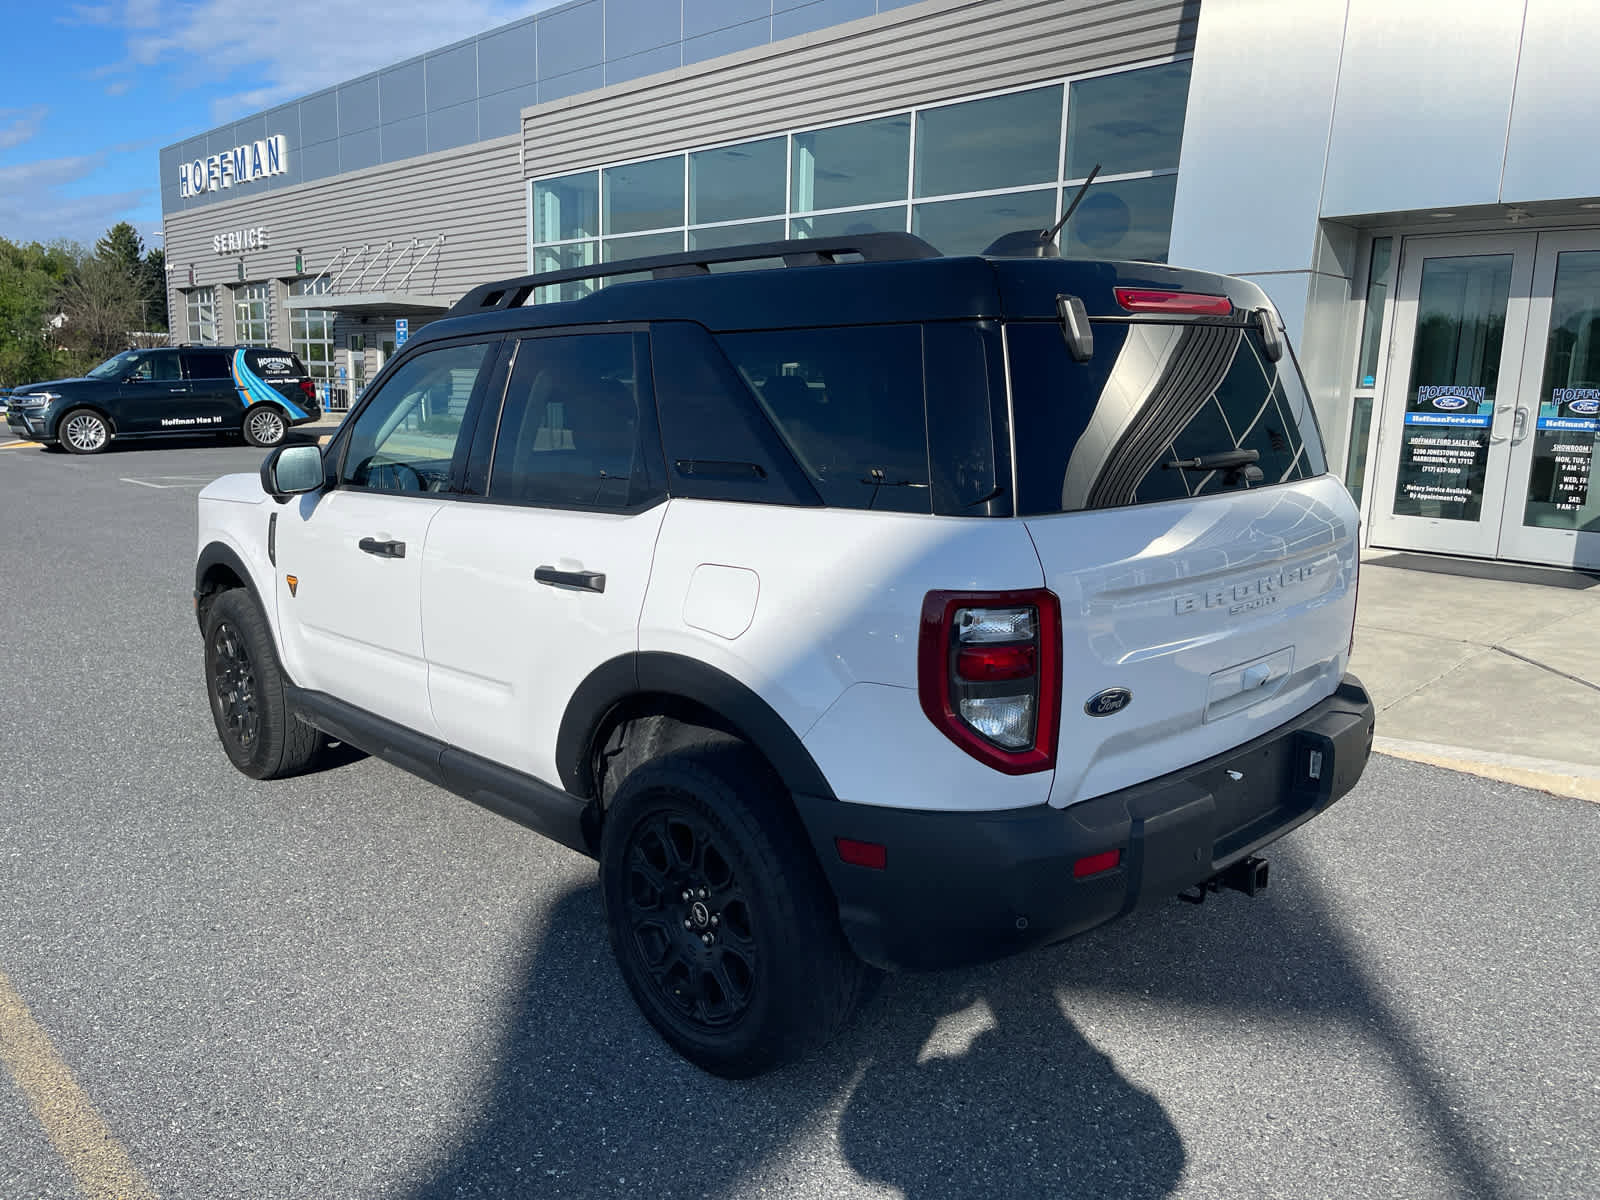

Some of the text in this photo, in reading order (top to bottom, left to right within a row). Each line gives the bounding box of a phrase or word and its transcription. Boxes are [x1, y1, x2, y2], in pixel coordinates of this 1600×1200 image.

[179, 135, 286, 198] HOFFMAN
[213, 227, 267, 253] SERVICE
[257, 357, 293, 368] HOFFMAN
[1417, 385, 1486, 405] HOFFMAN
[161, 418, 195, 426] Hoffman
[196, 416, 211, 424] Has
[1412, 415, 1485, 425] HoffmanFord.com
[1410, 437, 1436, 446] HOFFMAN
[1436, 438, 1451, 446] FORD
[1452, 439, 1468, 447] SALES
[1553, 444, 1588, 453] SHOWROOM
[1412, 455, 1448, 464] HARRISBURG,
[1563, 476, 1579, 484] WED,
[1406, 484, 1472, 495] Notary Service Available
[1409, 492, 1467, 503] By Appointment Only
[1175, 566, 1315, 616] BRONCO
[1229, 596, 1277, 616] SPORT
